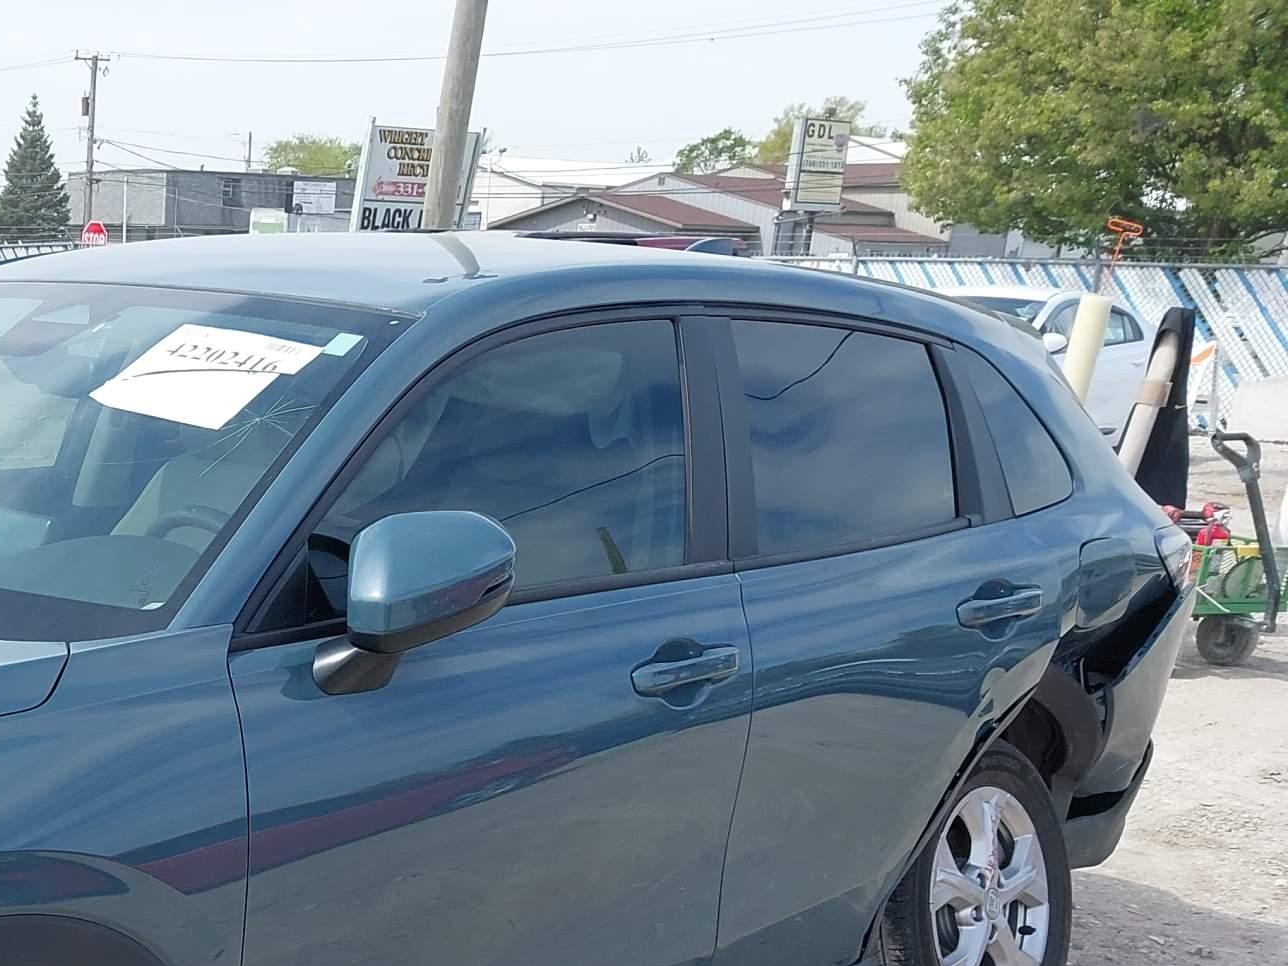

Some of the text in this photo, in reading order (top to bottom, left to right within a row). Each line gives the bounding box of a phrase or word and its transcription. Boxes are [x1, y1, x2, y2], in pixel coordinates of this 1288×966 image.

[379, 129, 429, 146] WRIGHT
[807, 122, 834, 140] GDL
[360, 206, 414, 230] BLACK
[84, 231, 105, 245] STOP
[166, 343, 281, 373] 42202416
